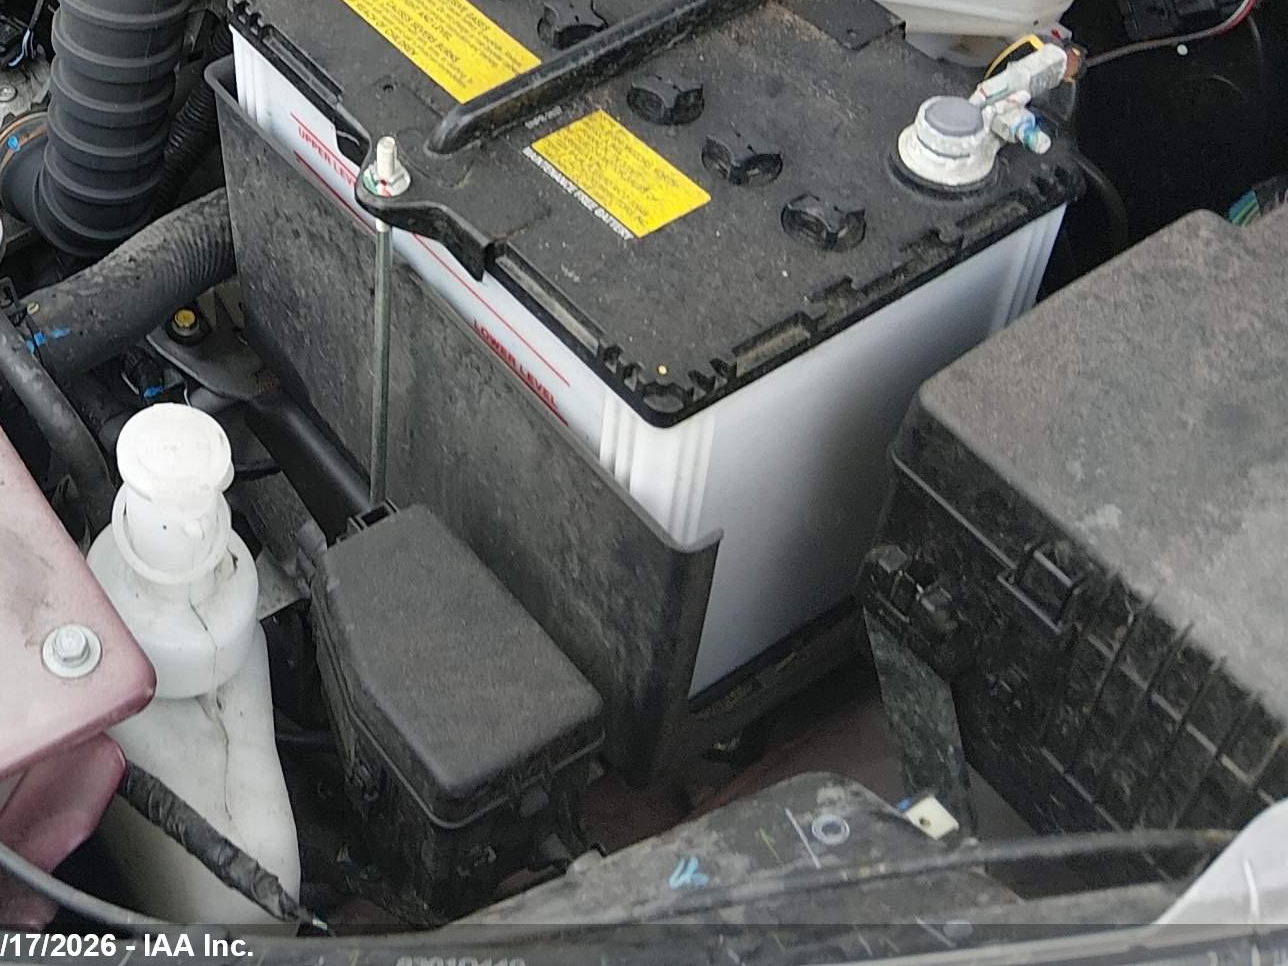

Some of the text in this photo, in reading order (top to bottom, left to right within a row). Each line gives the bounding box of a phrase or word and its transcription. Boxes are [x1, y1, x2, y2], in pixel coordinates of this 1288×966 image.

[298, 126, 356, 187] UPPER LEV
[473, 319, 558, 409] LOWER LEVEL
